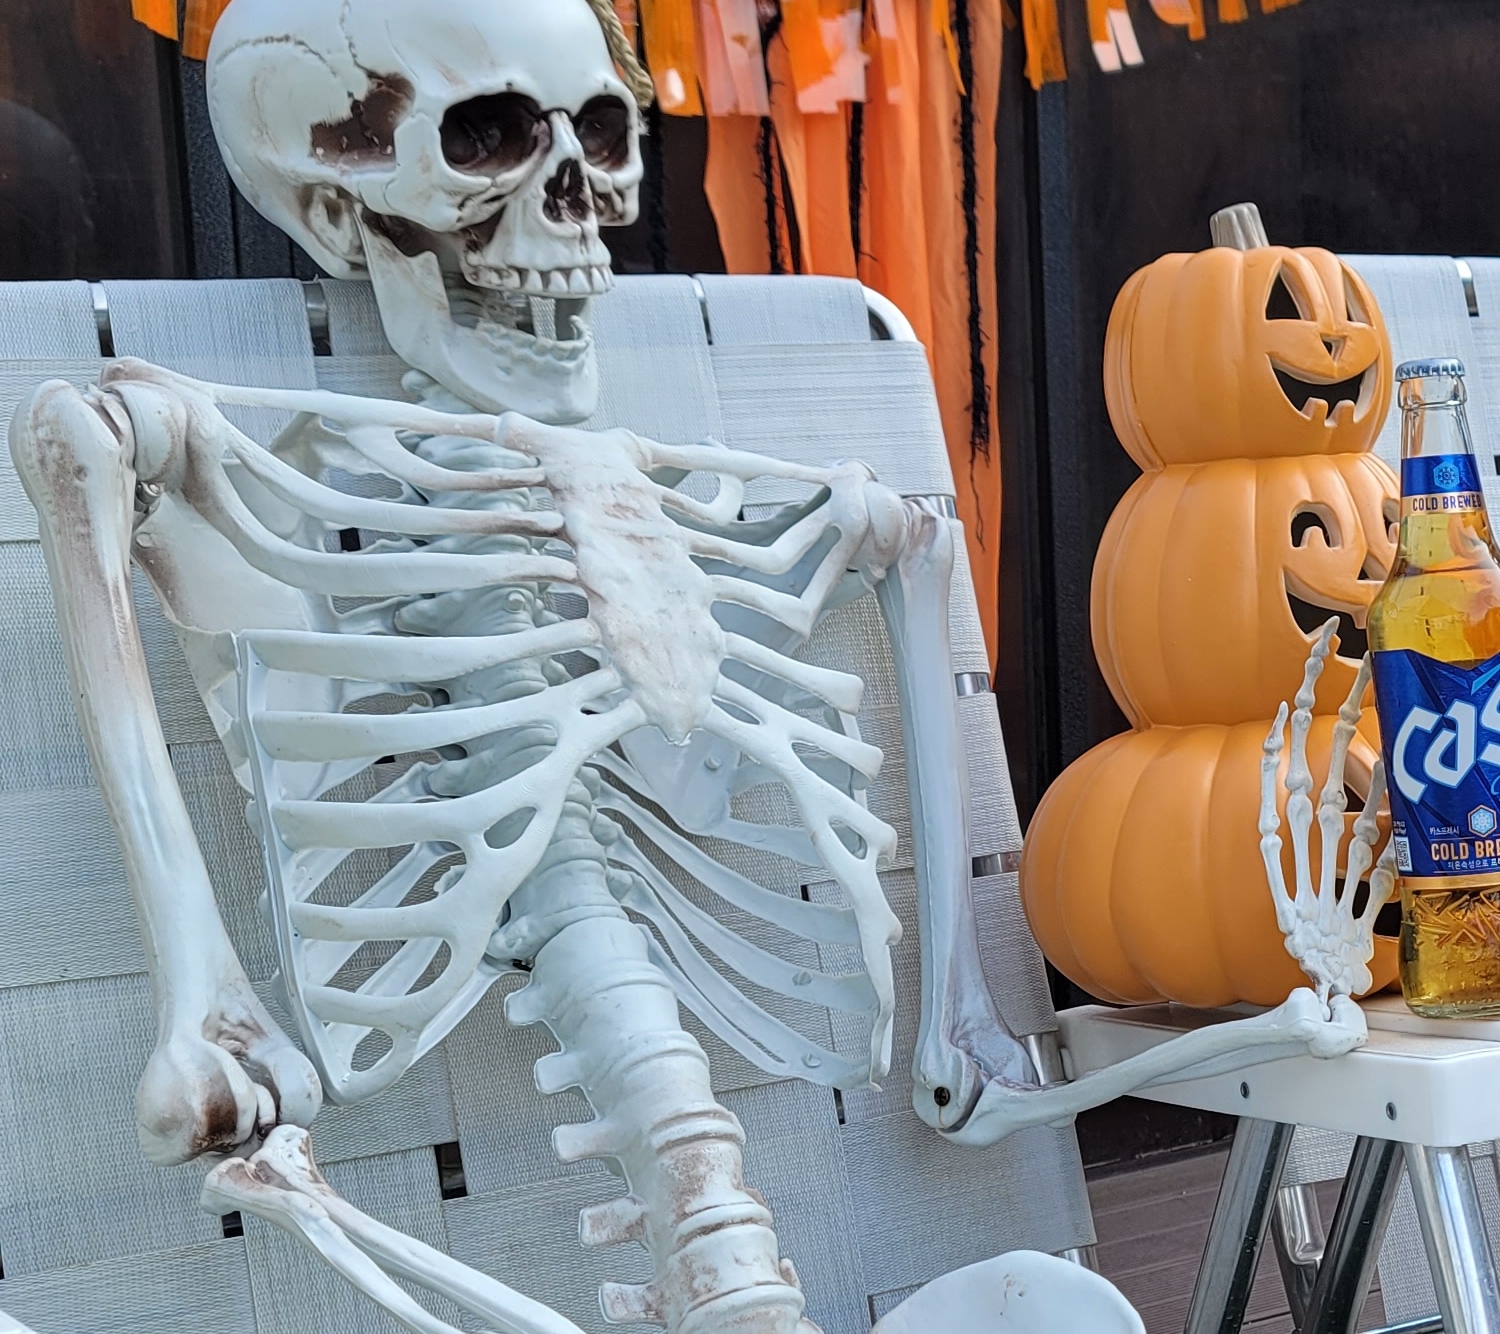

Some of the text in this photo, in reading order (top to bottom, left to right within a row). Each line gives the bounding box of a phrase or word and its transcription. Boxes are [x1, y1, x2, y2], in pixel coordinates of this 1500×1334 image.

[1413, 493, 1482, 511] COLD BREWED
[1431, 842, 1469, 861] COLD
